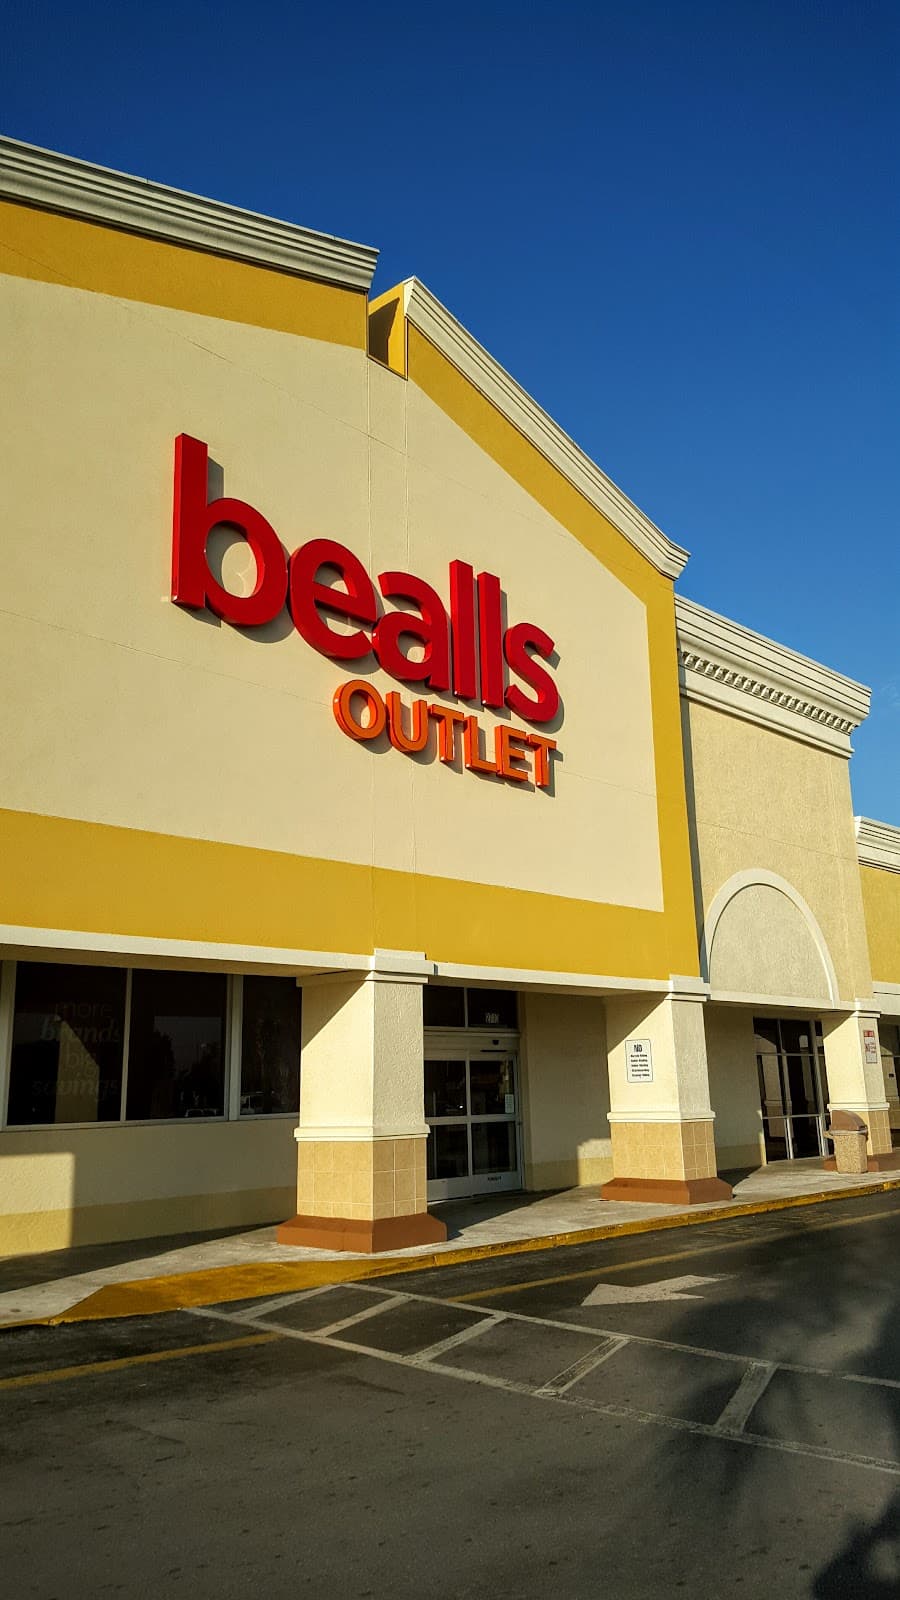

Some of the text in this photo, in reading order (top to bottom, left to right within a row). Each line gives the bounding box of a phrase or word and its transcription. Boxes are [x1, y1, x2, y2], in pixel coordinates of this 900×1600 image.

[171, 433, 560, 723] bealls
[333, 679, 557, 788] OUTLET
[55, 1002, 113, 1019] more
[633, 1044, 643, 1053] NO
